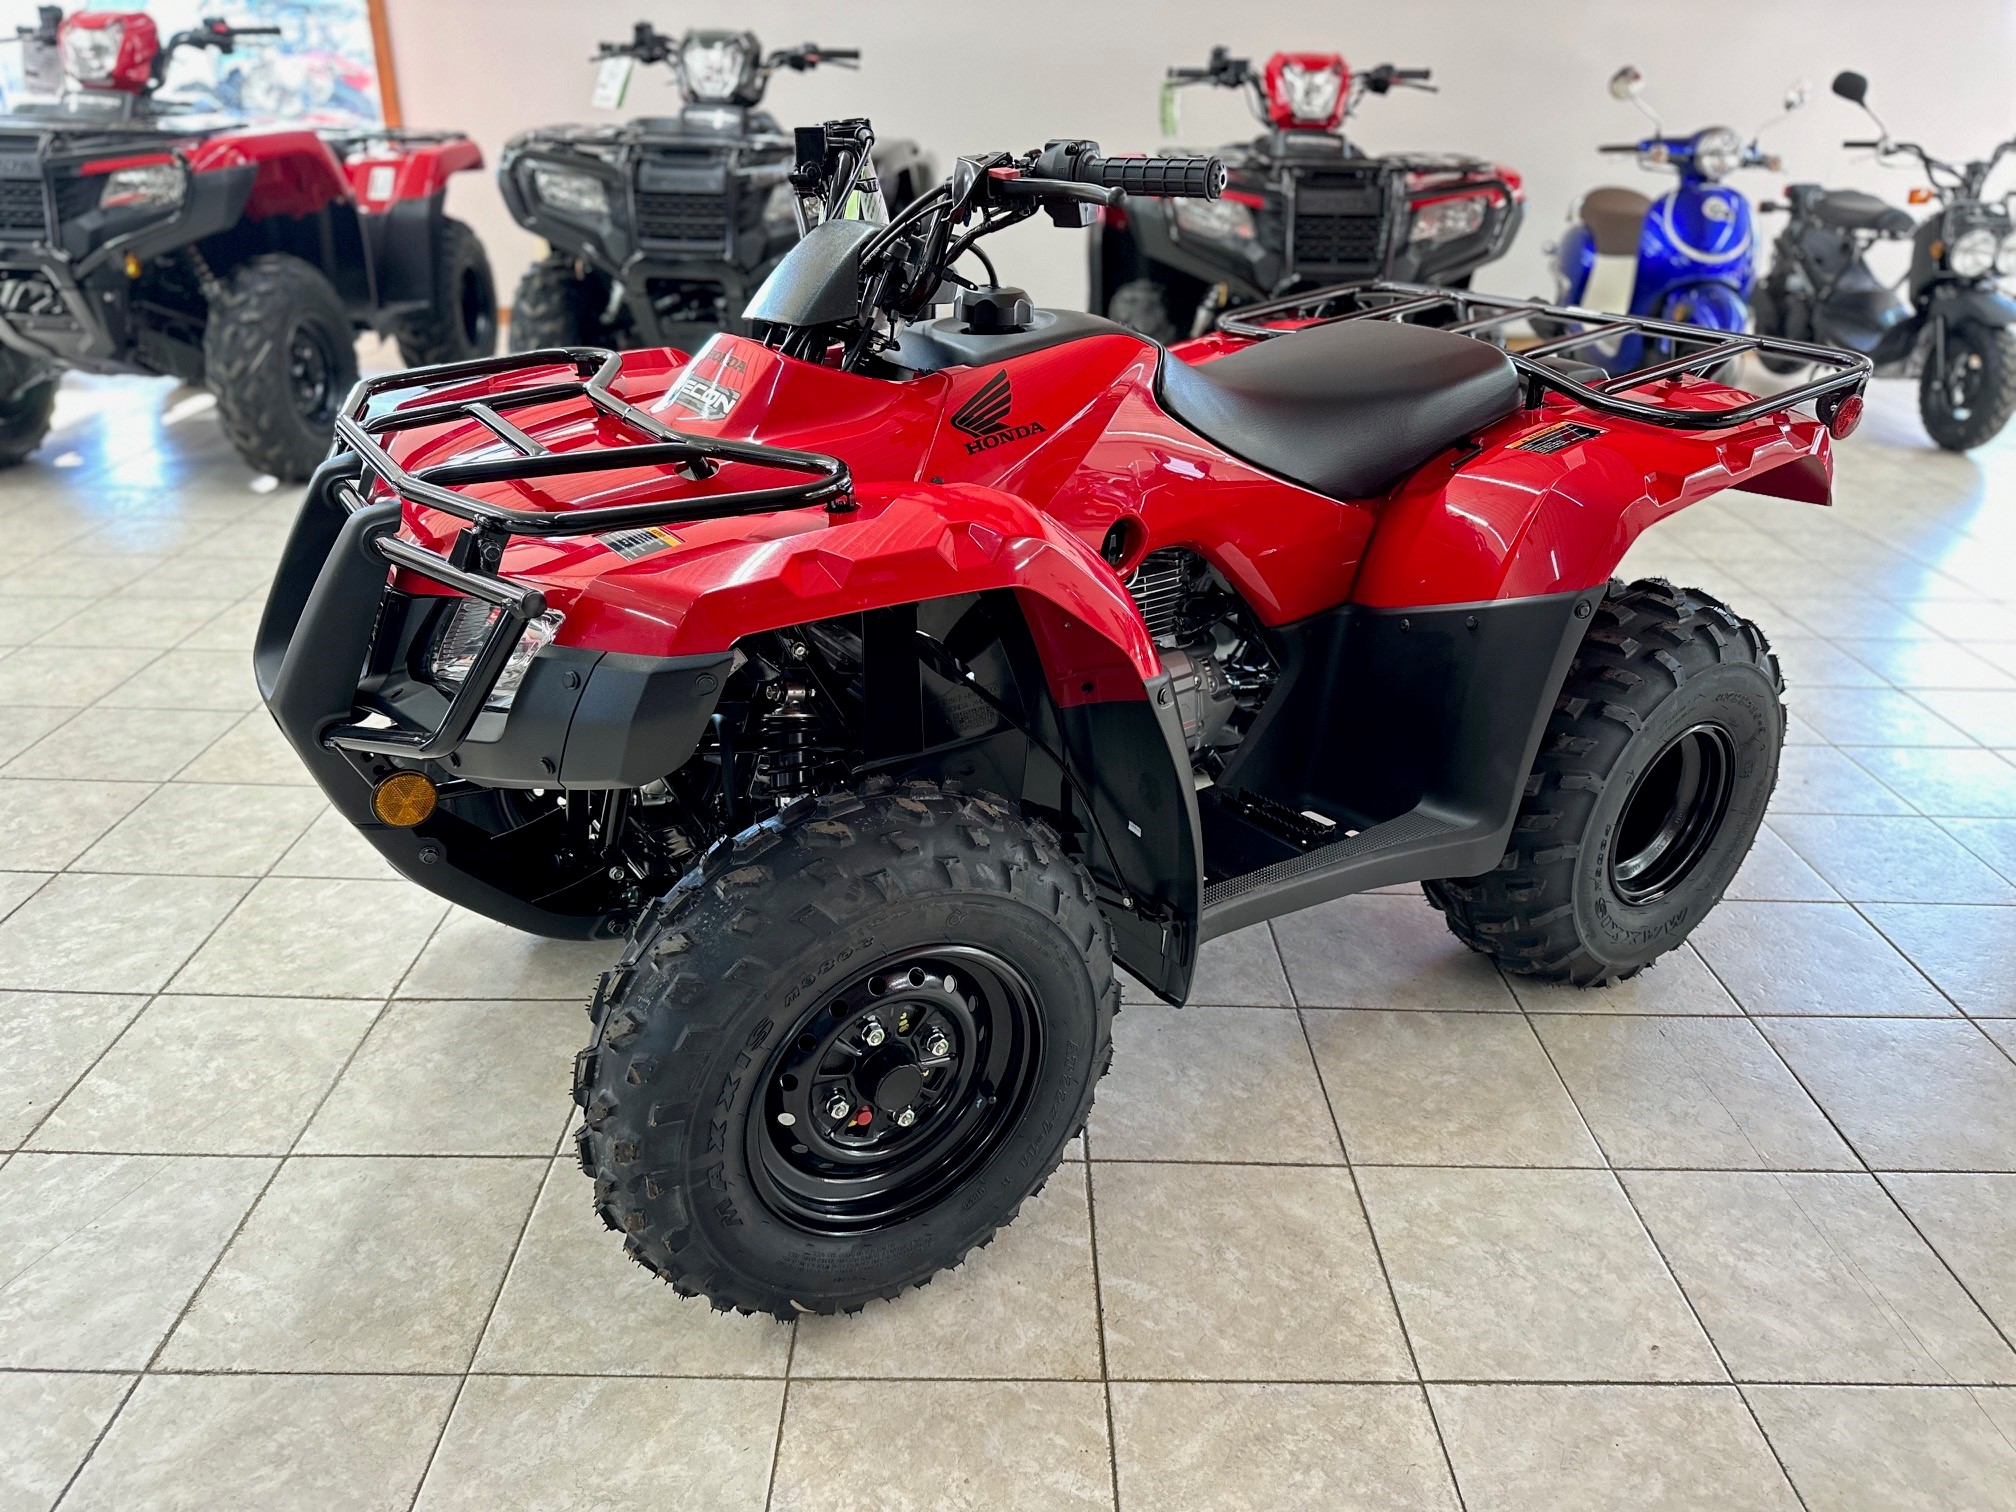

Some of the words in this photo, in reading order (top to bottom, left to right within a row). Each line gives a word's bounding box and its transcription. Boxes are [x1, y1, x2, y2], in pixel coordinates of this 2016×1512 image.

[964, 421, 1047, 455] HONDA
[1594, 897, 1689, 945] MAXXIS
[708, 1016, 775, 1228] MAXXIS
